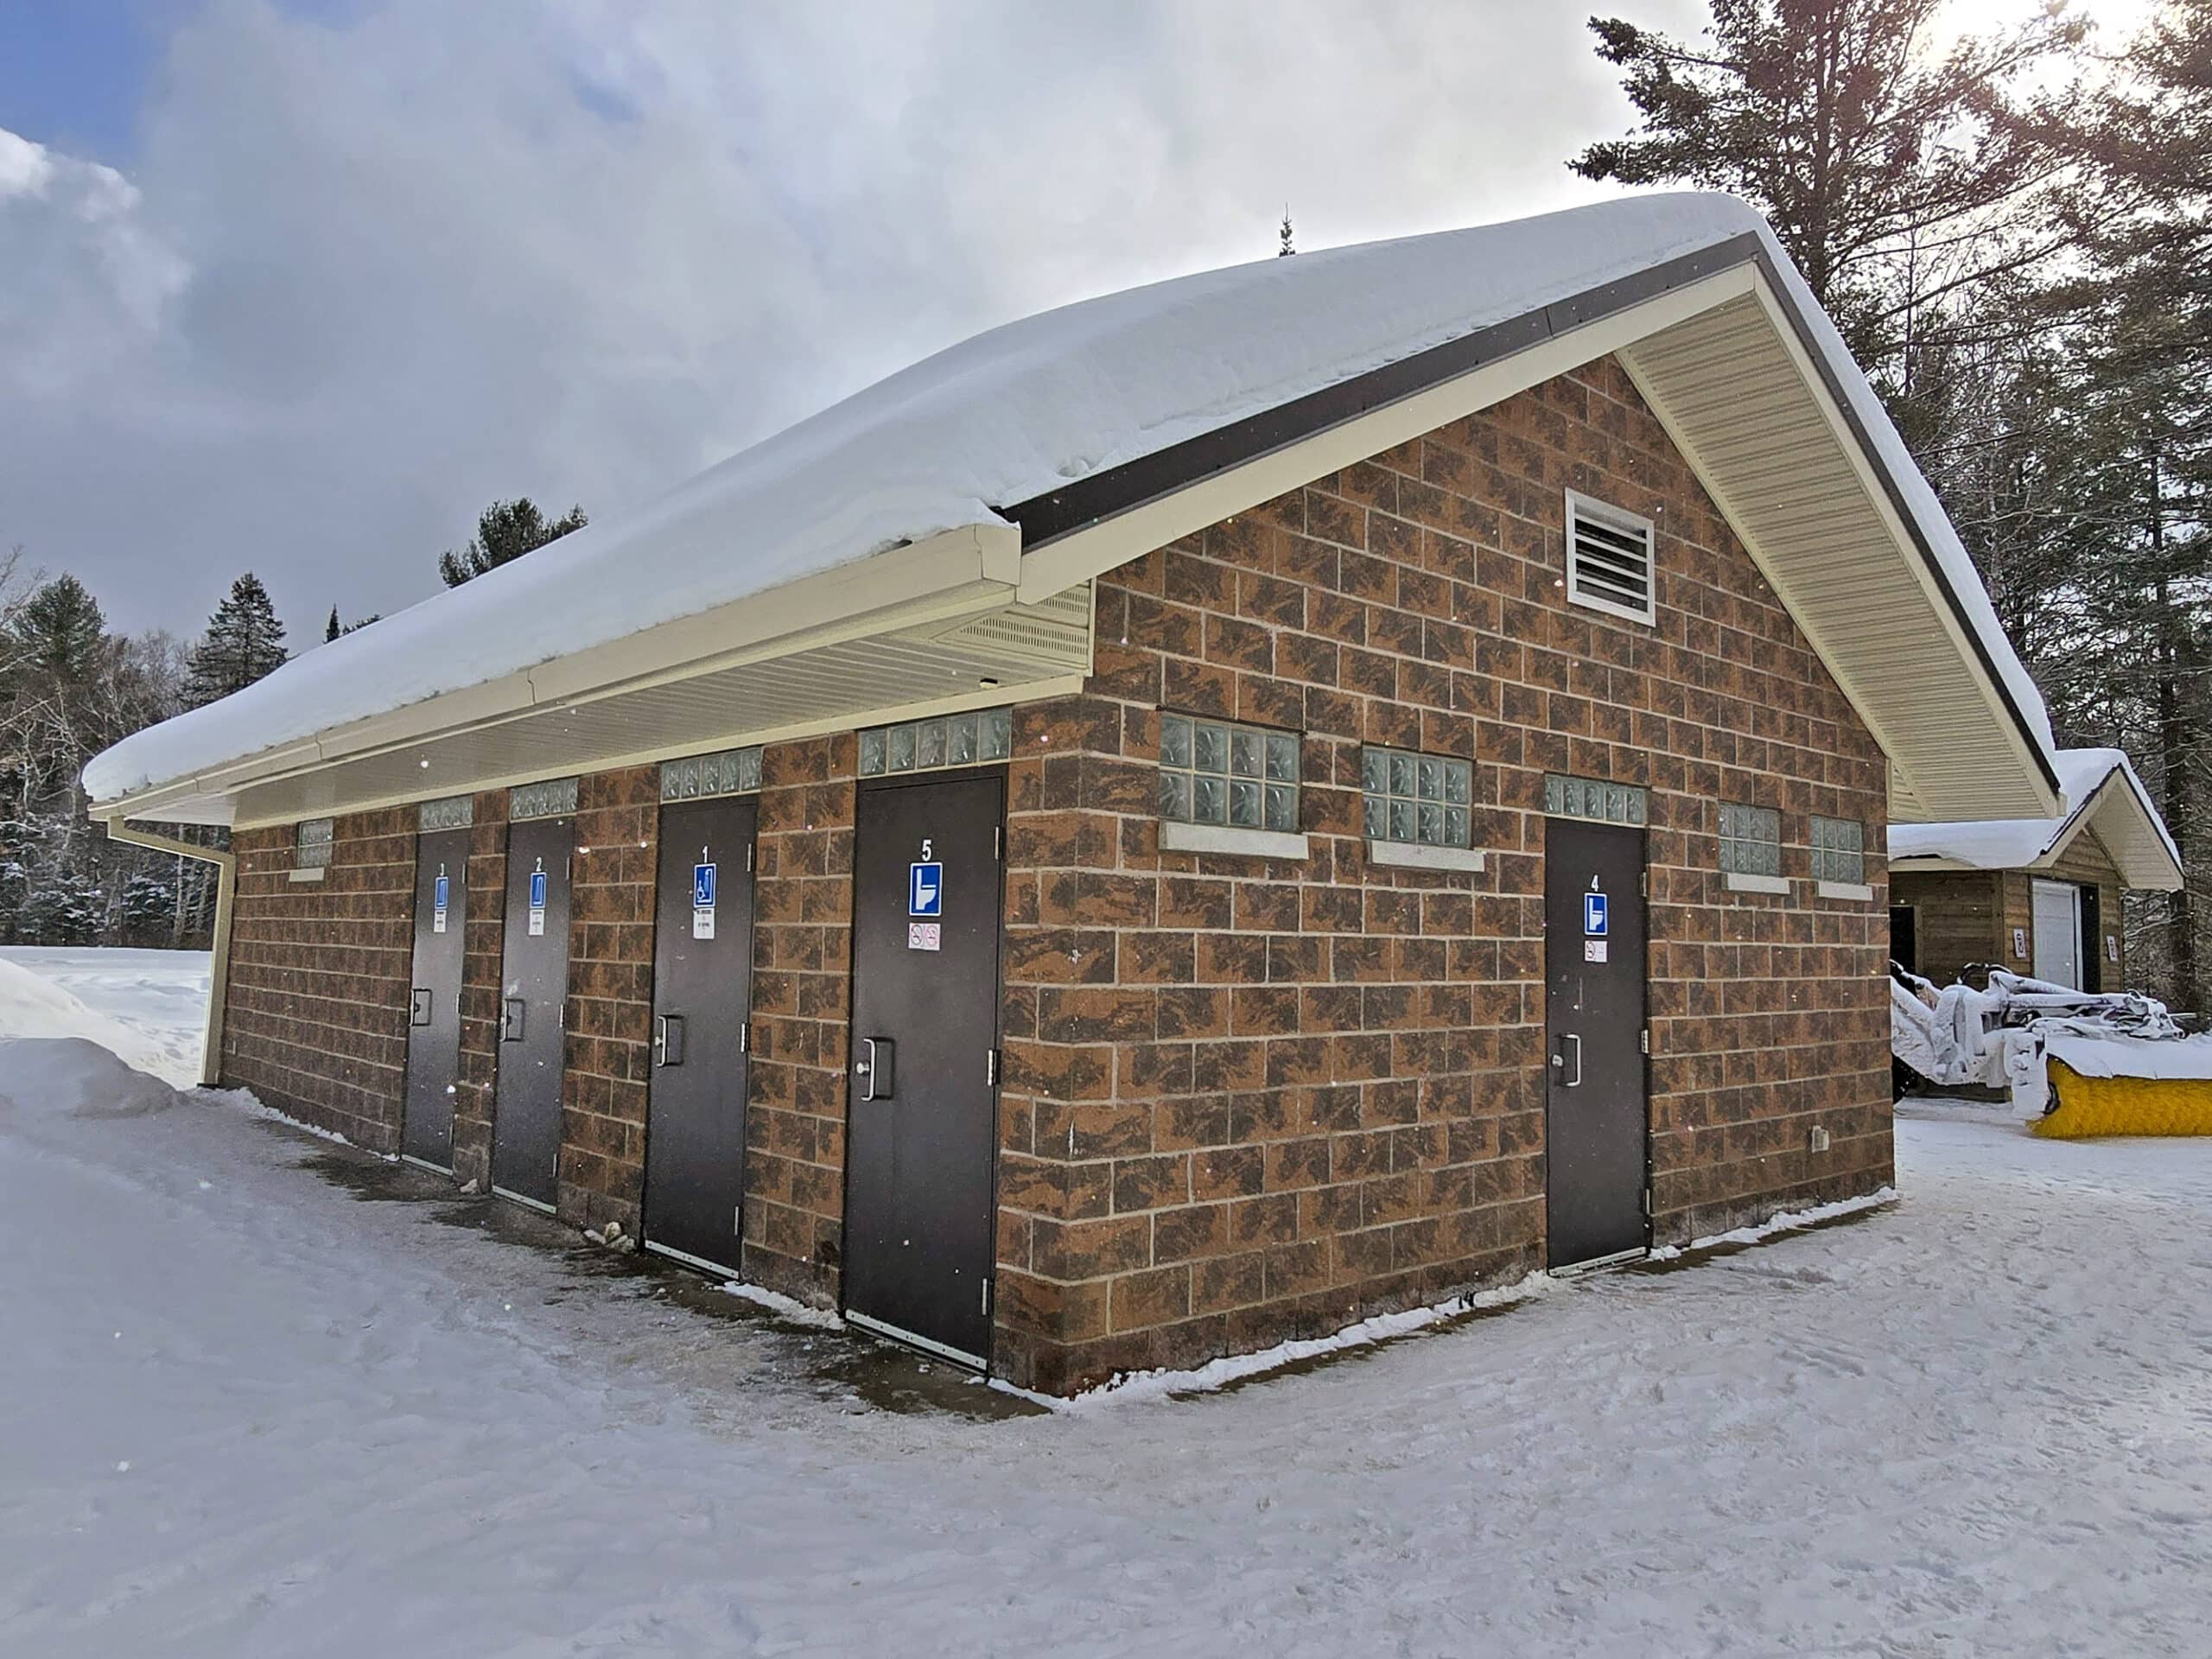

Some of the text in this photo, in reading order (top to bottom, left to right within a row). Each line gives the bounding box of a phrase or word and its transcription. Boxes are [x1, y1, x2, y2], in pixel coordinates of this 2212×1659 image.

[702, 845, 709, 863] 1
[922, 839, 932, 861] 5
[536, 856, 543, 872] 2
[1591, 874, 1599, 892] 4
